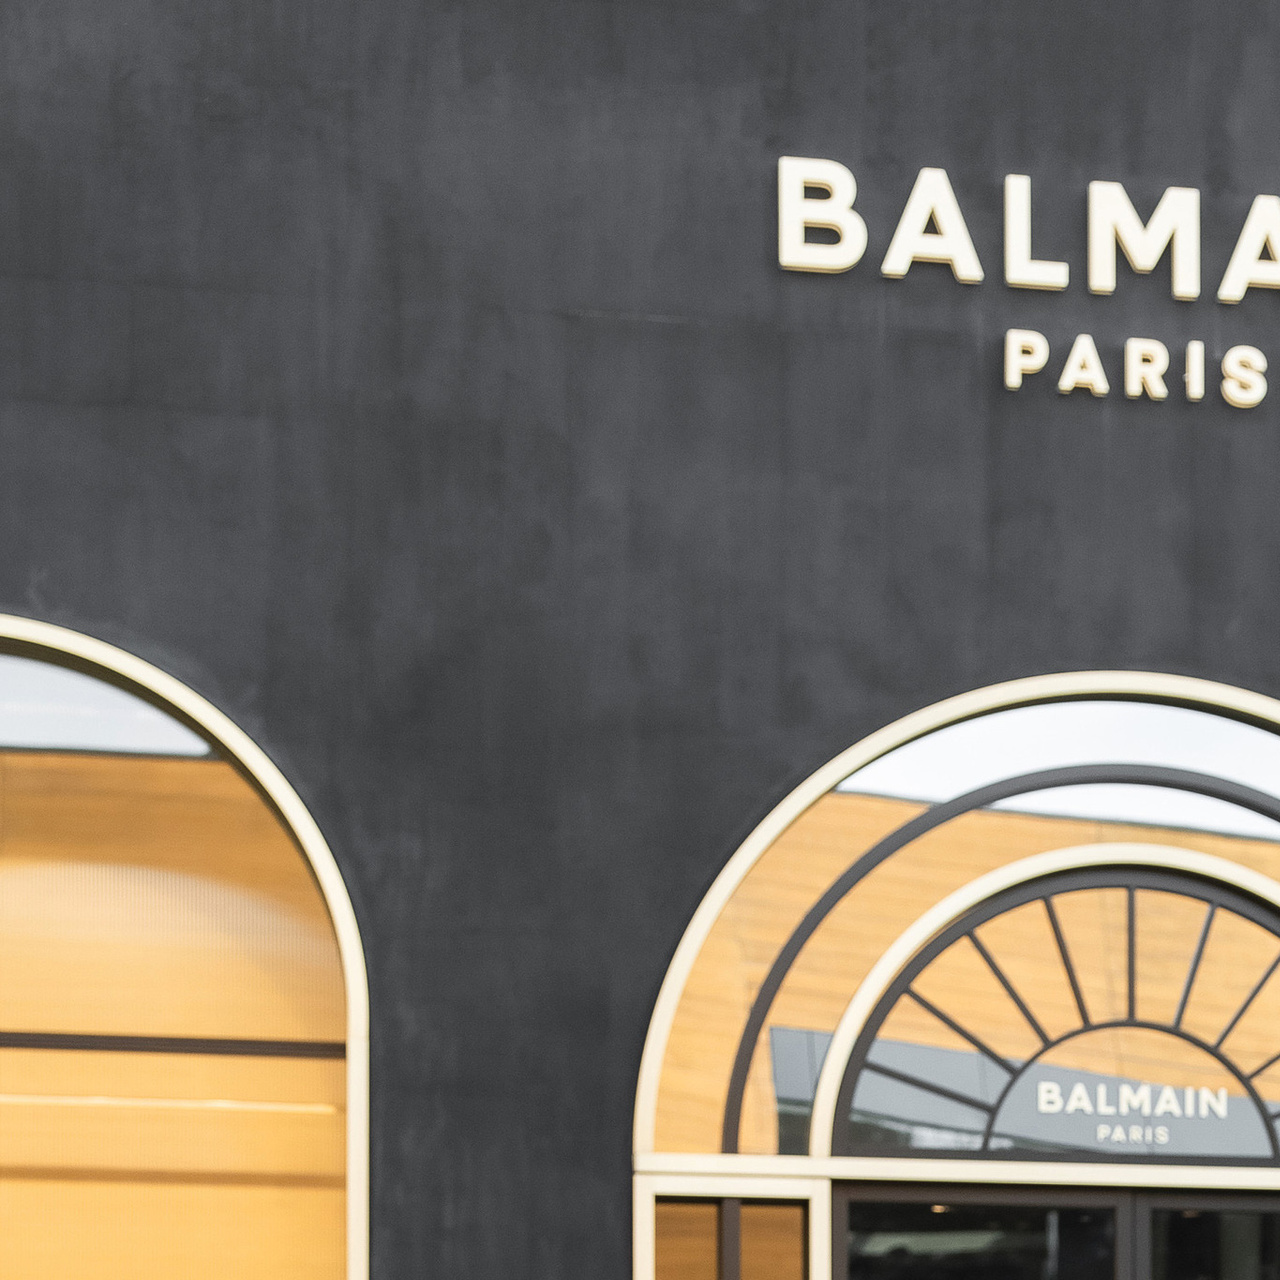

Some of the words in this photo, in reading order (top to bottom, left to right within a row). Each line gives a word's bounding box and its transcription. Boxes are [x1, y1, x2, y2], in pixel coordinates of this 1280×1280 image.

[1004, 329, 1269, 408] PARIS
[1038, 1081, 1229, 1119] BALMAIN
[1096, 1125, 1169, 1145] PARIS
